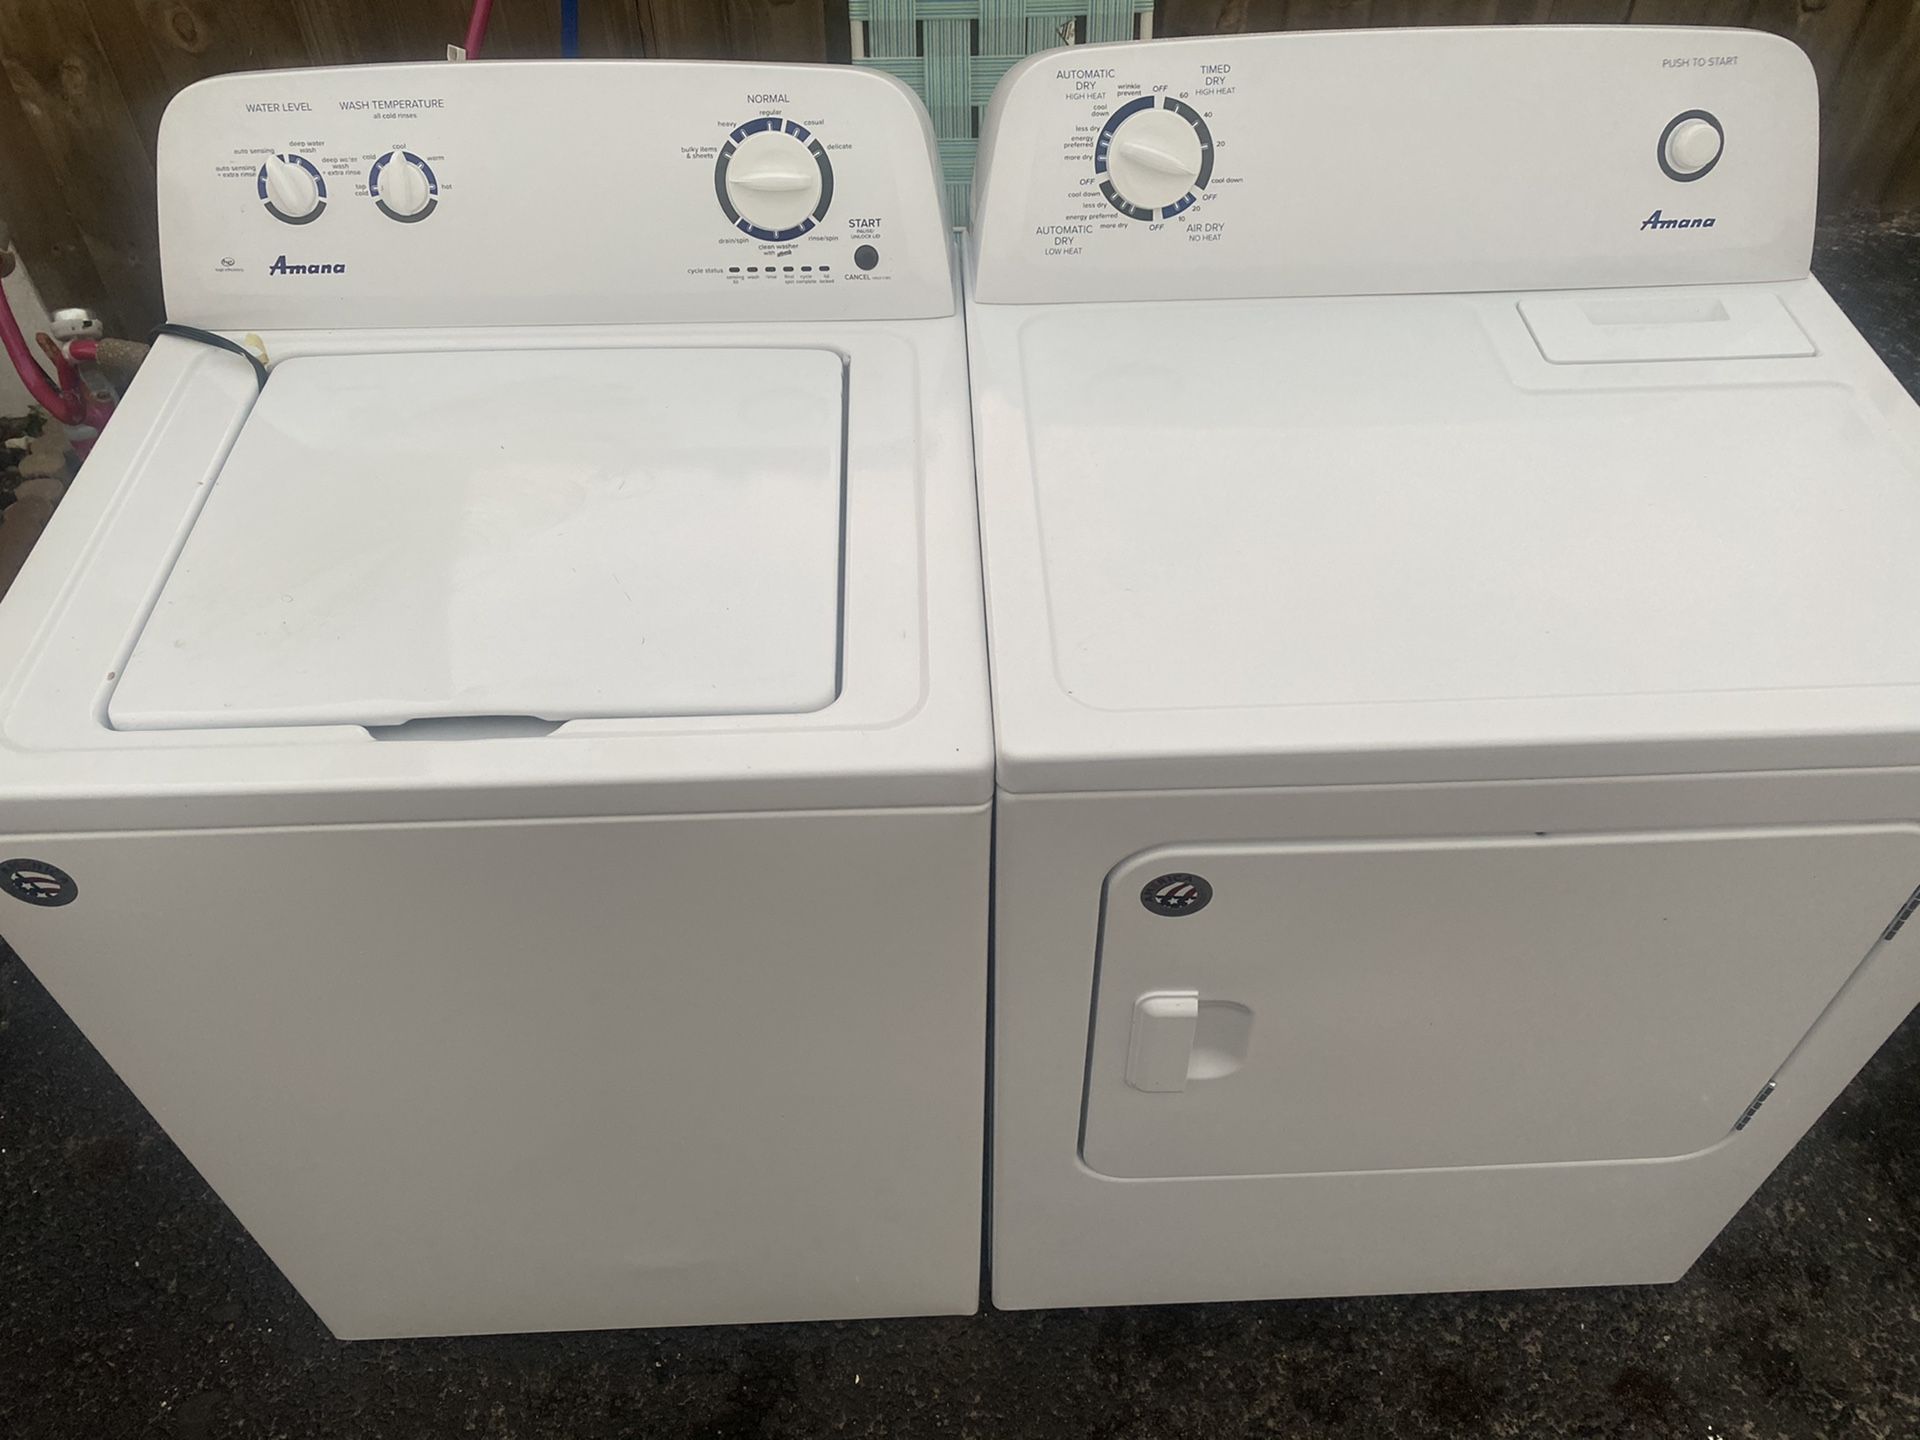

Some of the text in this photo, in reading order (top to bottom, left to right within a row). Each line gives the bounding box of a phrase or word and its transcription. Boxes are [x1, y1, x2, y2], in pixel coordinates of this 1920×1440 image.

[1663, 56, 1738, 68] PUSH TO START
[1200, 64, 1231, 73] TIMED
[1056, 69, 1115, 79] AUTOMATIC
[1076, 81, 1096, 90] DRY
[1205, 76, 1226, 86] DRY
[747, 94, 790, 104] NORMAL
[246, 102, 312, 113] WATER LEVEL
[339, 99, 444, 110] WASH TEMPERATURE
[759, 109, 782, 117] regular
[848, 218, 881, 228] START
[1640, 210, 1716, 231] Amana
[1036, 225, 1093, 234] AUTOMATIC
[1187, 223, 1224, 232] AIR DRY
[718, 237, 749, 245] drain/spin
[1054, 237, 1074, 245] DRY
[1063, 247, 1082, 255] HEAT
[269, 255, 345, 275] Amana
